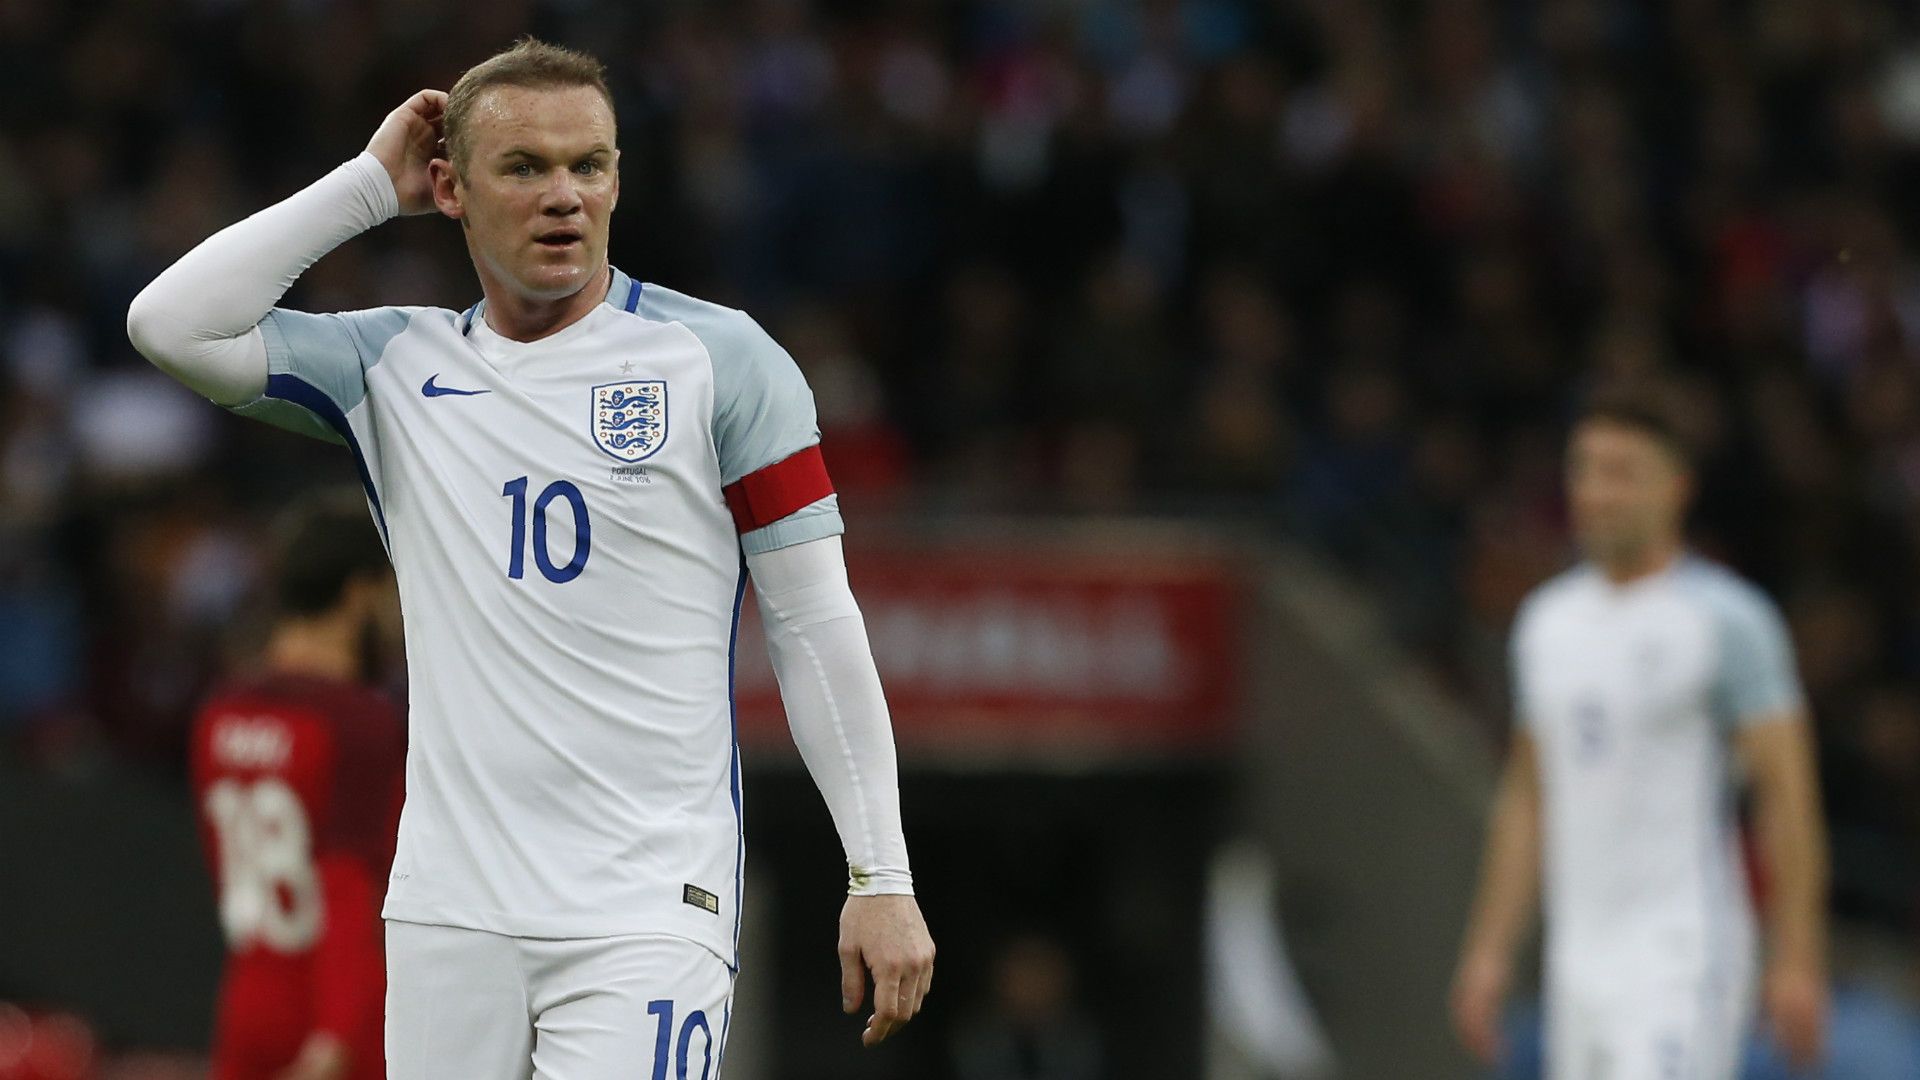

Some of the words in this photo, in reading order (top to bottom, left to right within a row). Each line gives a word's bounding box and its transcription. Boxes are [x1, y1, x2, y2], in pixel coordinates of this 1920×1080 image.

[611, 467, 648, 476] PORTUGAL
[502, 475, 591, 584] 10
[205, 778, 326, 952] 18
[647, 999, 712, 1080] 10
